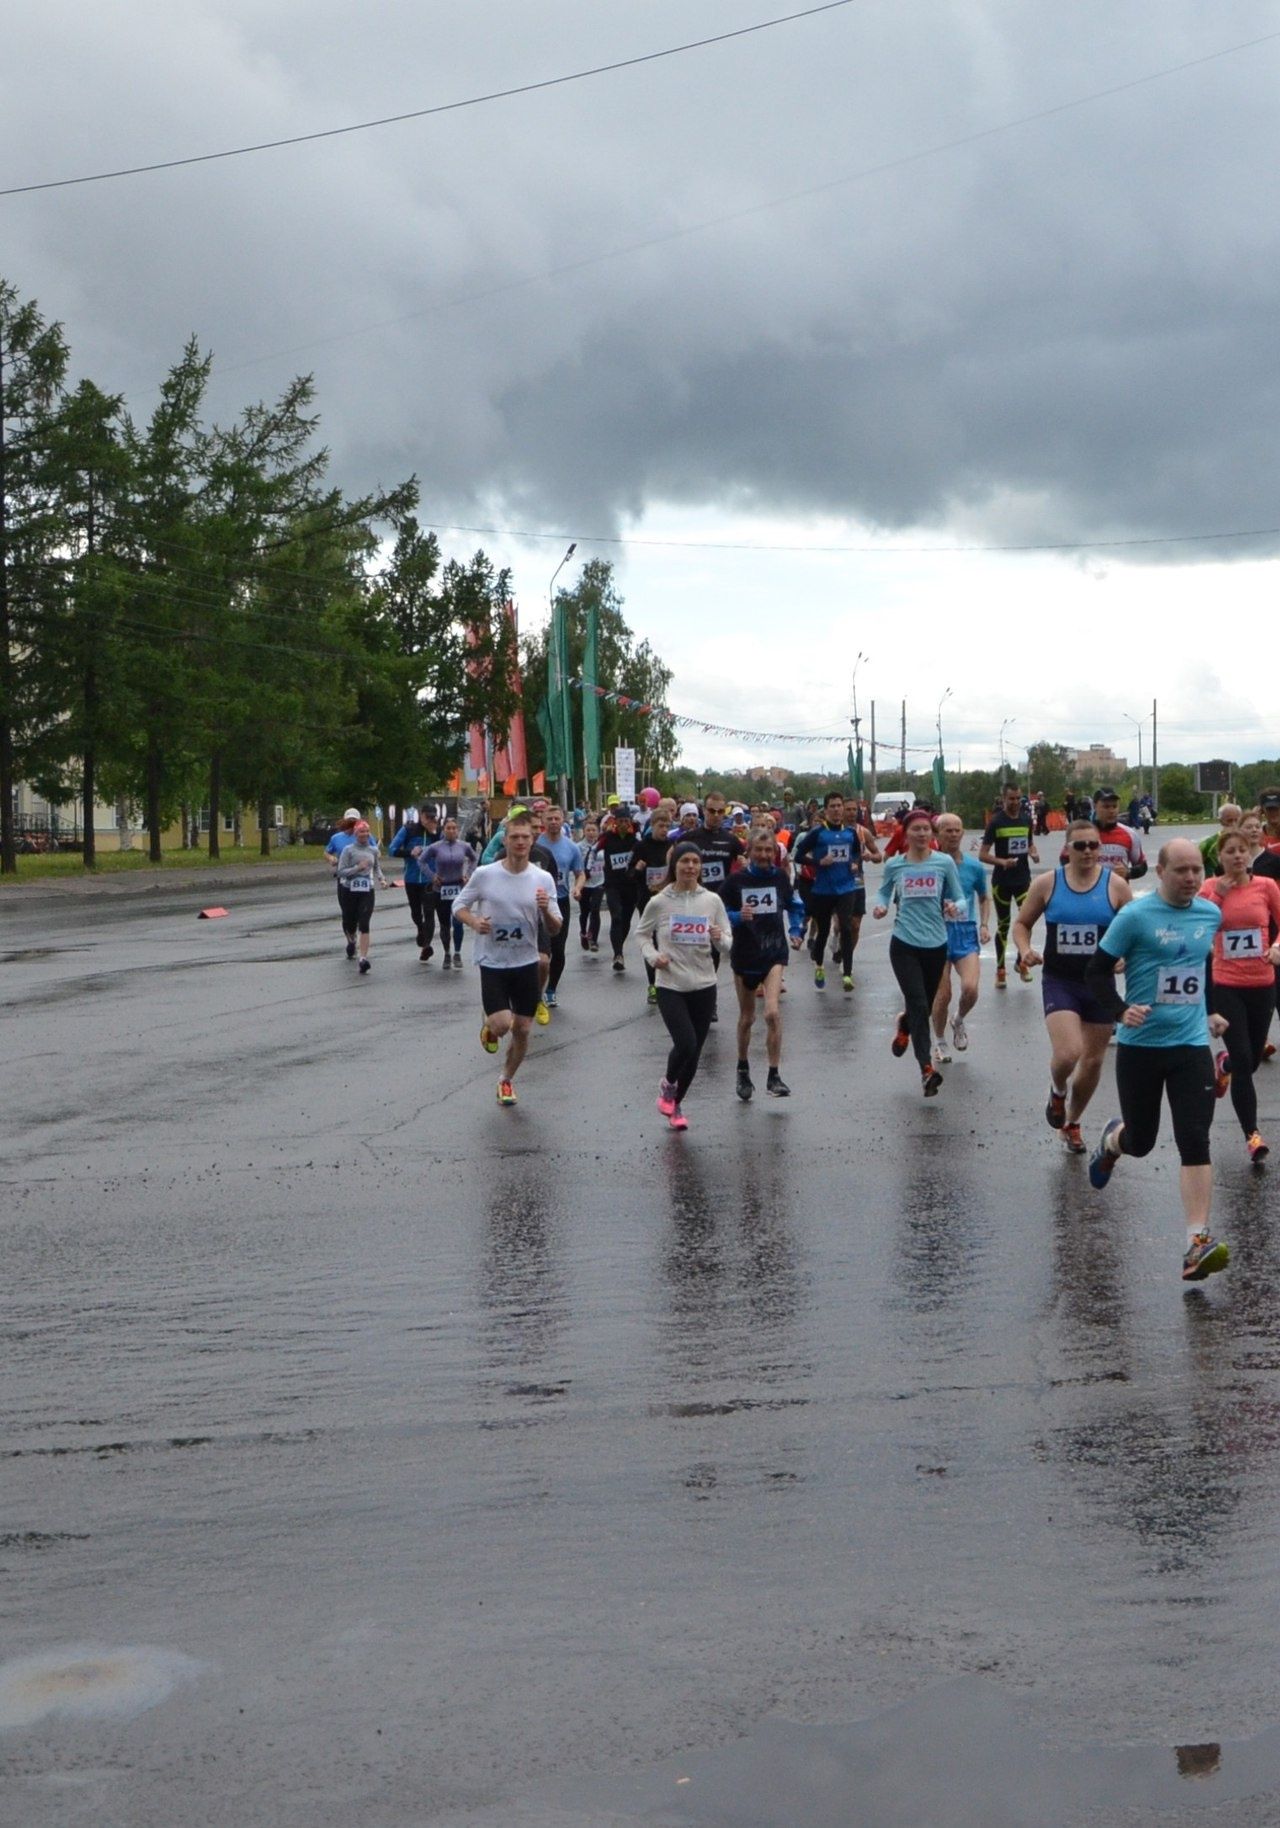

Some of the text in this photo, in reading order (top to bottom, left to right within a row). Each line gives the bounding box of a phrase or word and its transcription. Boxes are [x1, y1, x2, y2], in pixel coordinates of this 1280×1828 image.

[1010, 840, 1027, 850] 25
[904, 877, 936, 888] 240
[496, 927, 524, 942] 24
[672, 922, 706, 934] 220
[1059, 930, 1096, 946] 118
[1226, 934, 1259, 951] 71
[1163, 975, 1199, 995] 16
